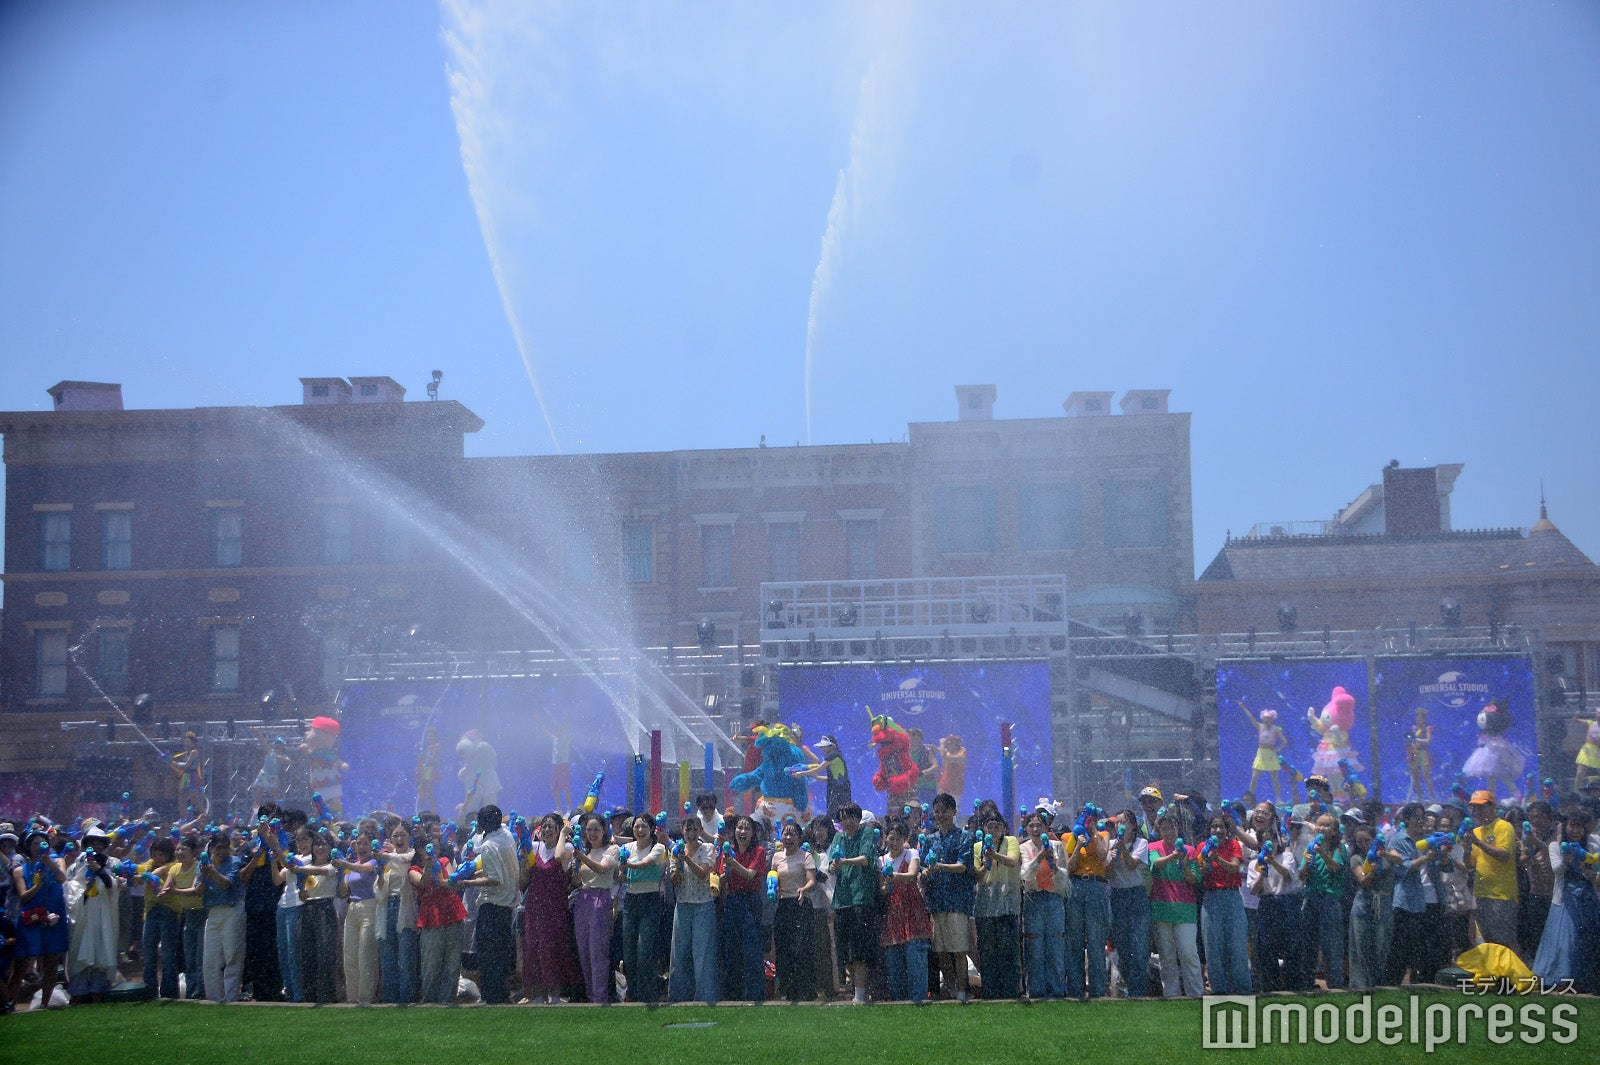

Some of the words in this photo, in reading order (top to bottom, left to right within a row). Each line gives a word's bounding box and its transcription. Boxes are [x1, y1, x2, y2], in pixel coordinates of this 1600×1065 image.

[1419, 683, 1457, 694] UNIVERSAL
[1459, 683, 1489, 693] STUDIOS
[881, 690, 916, 701] UNIVERSAL
[919, 690, 946, 700] STUDIOS
